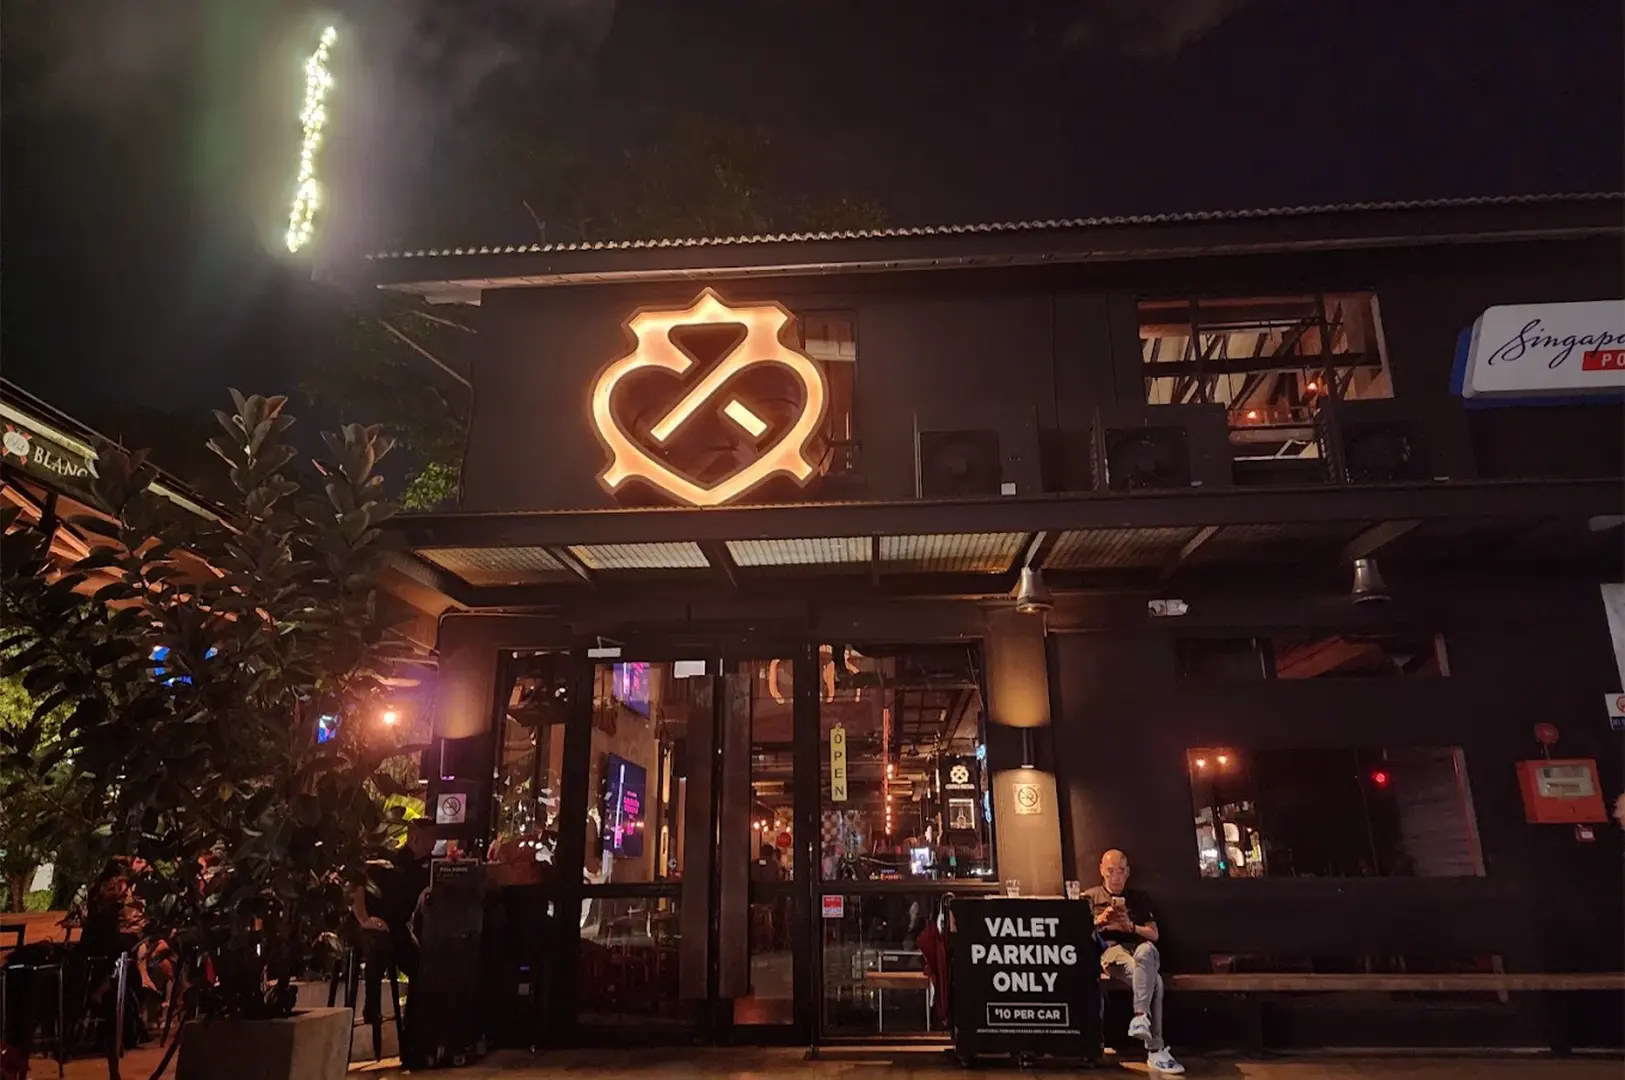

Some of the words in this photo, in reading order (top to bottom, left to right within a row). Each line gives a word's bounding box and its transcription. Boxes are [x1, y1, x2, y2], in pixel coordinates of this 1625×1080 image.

[834, 733, 844, 797] OPEN
[984, 917, 1059, 938] VALET
[971, 944, 1078, 966] PARKING
[992, 971, 1058, 993] ONLY
[994, 1008, 1012, 1020] $10
[1014, 1009, 1035, 1020] PER
[1037, 1009, 1061, 1020] CAR
